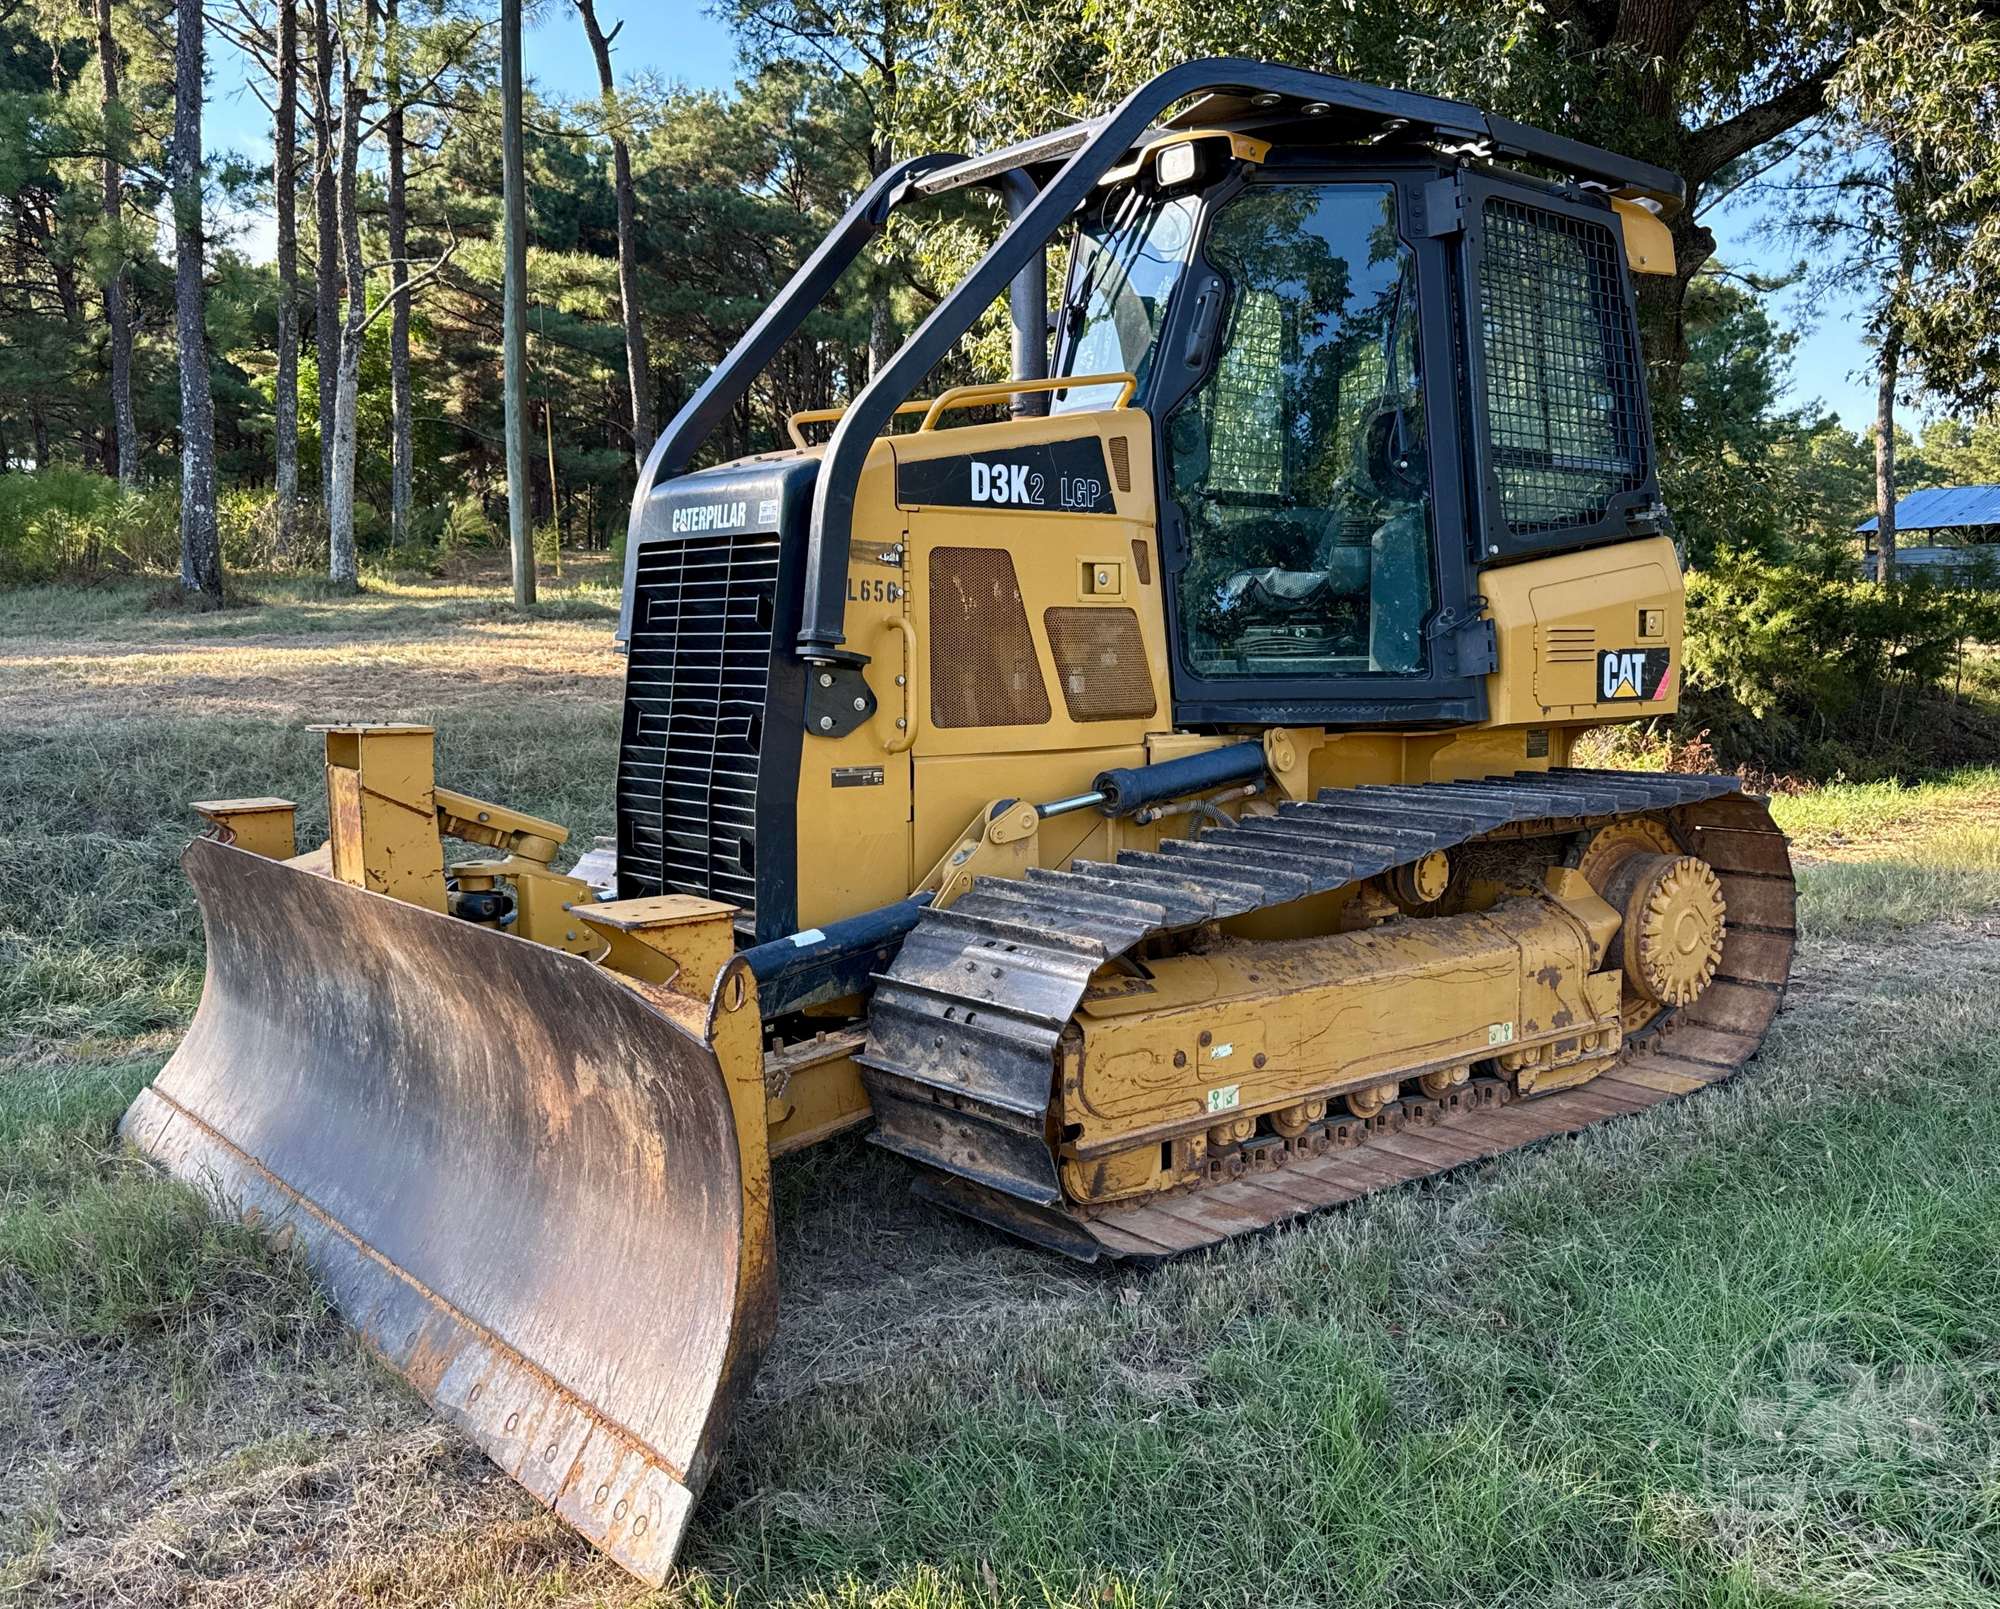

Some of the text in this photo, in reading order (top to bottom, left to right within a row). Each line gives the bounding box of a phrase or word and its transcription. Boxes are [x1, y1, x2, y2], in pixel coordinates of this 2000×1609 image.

[971, 462, 1101, 508] D3K2 LGP
[672, 502, 747, 533] CATERPILLAR
[1603, 653, 1646, 698] CAT
